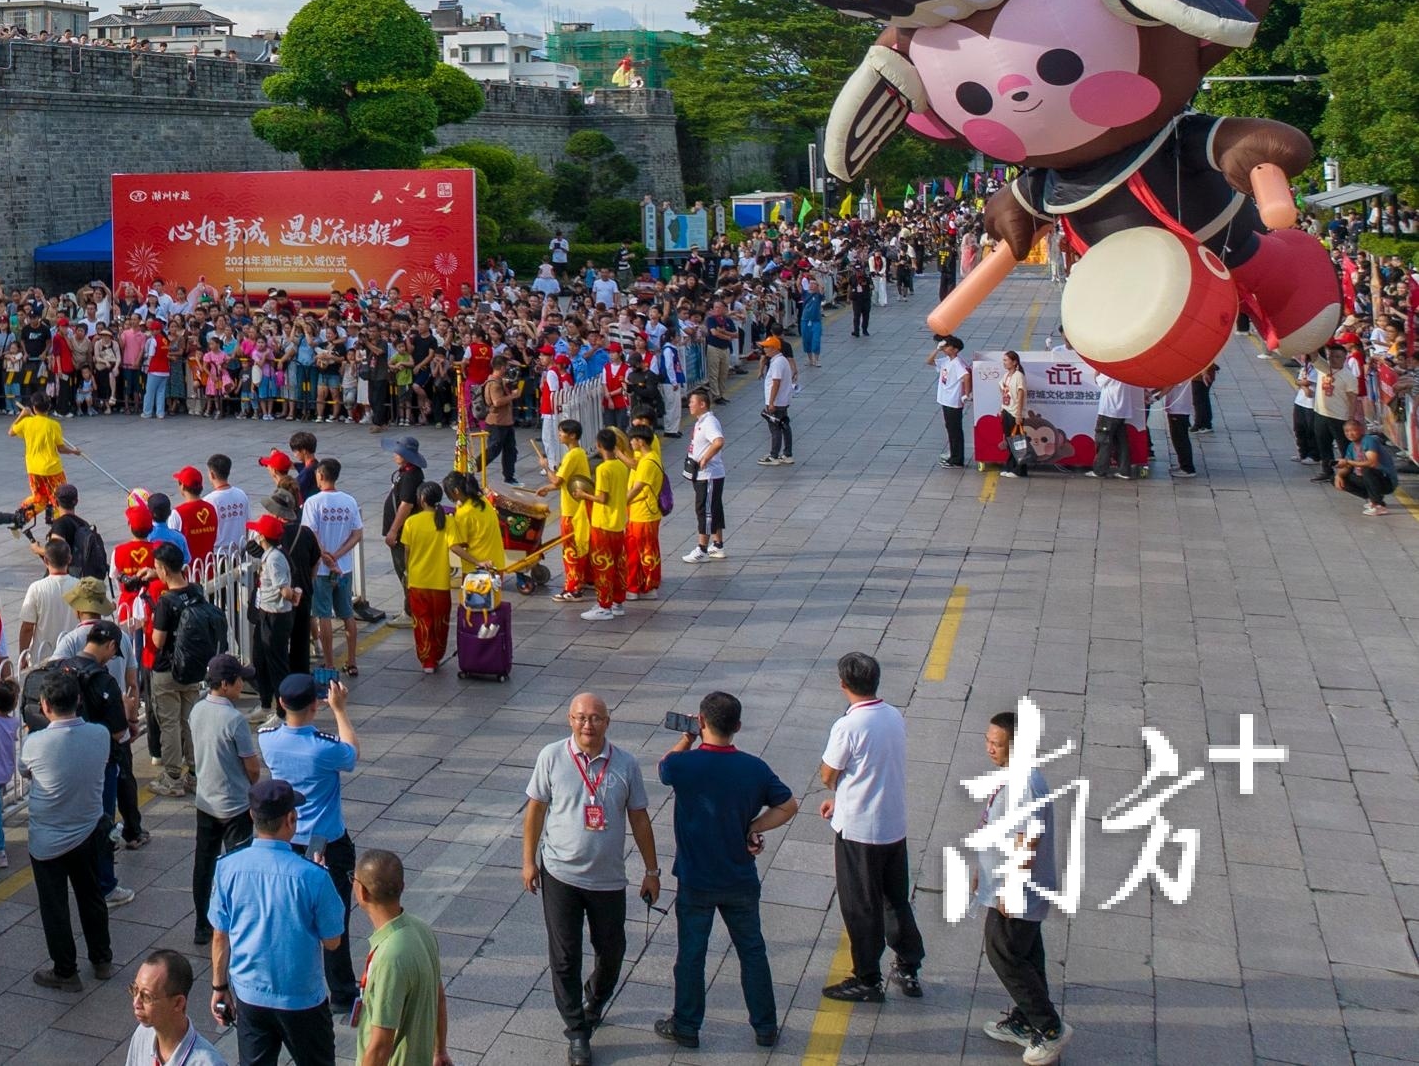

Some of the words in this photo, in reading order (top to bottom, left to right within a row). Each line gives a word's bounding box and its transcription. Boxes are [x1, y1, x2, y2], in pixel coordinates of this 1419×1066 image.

[168, 215, 270, 253] 心想事成
[225, 255, 347, 267] 2024年潮州古城入城仪式
